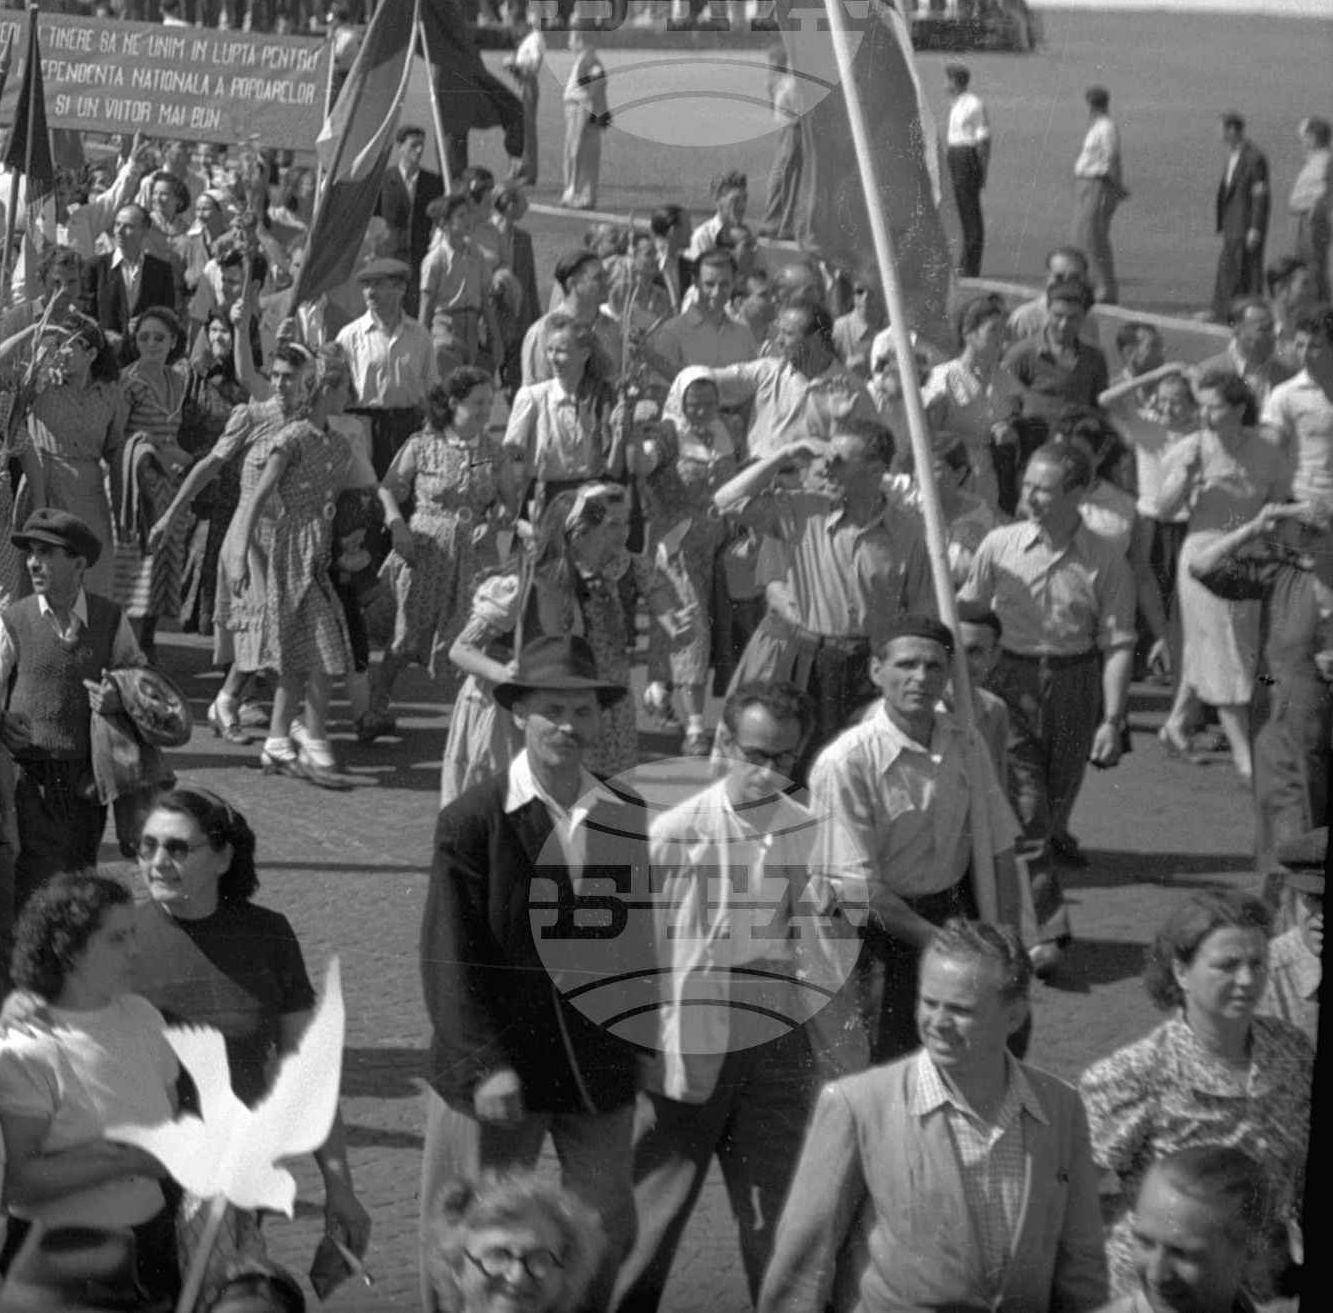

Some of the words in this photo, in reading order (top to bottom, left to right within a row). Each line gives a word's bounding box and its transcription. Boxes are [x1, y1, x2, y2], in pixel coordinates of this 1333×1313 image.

[50, 25, 94, 52] TINERE
[100, 30, 116, 53] SA
[121, 32, 141, 57] NE
[148, 34, 186, 61] UNIM
[191, 39, 209, 62] IN
[212, 41, 256, 66] LUPTA
[132, 67, 210, 96] NATIONALA
[213, 75, 225, 97] A
[54, 93, 71, 117] SI
[76, 95, 100, 119] UN
[104, 97, 152, 123] VIITOR
[158, 102, 186, 126] MAI
